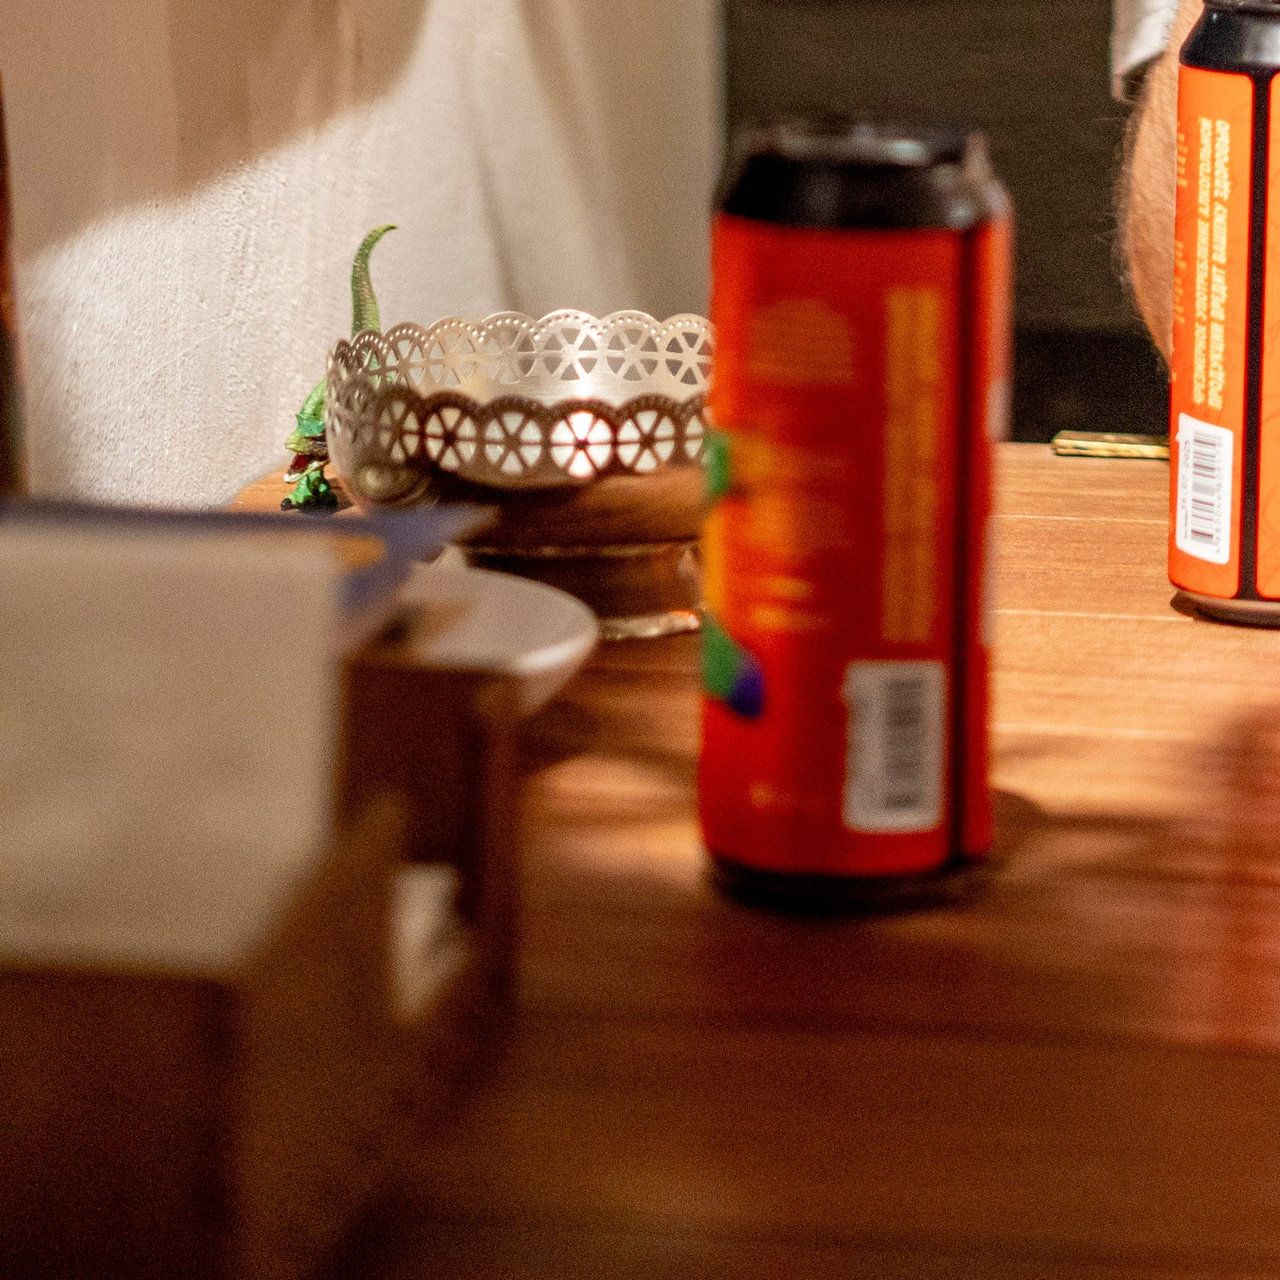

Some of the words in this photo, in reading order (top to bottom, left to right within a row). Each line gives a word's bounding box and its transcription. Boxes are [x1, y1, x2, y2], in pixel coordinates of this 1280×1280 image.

[1197, 116, 1213, 217] АЛКОГОЛЬНОЙ
[1213, 120, 1230, 201] ЗДОРОВЬЮ
[1195, 219, 1209, 320] УПОТРЕБЛЕНИЕ
[1212, 203, 1228, 264] ВАШЕМУ
[1210, 266, 1227, 320] ВРЕДИТ
[1193, 323, 1207, 404] ЧРЕЗМЕРНОЕ
[1208, 322, 1225, 409] ПРОДУКЦИИ
